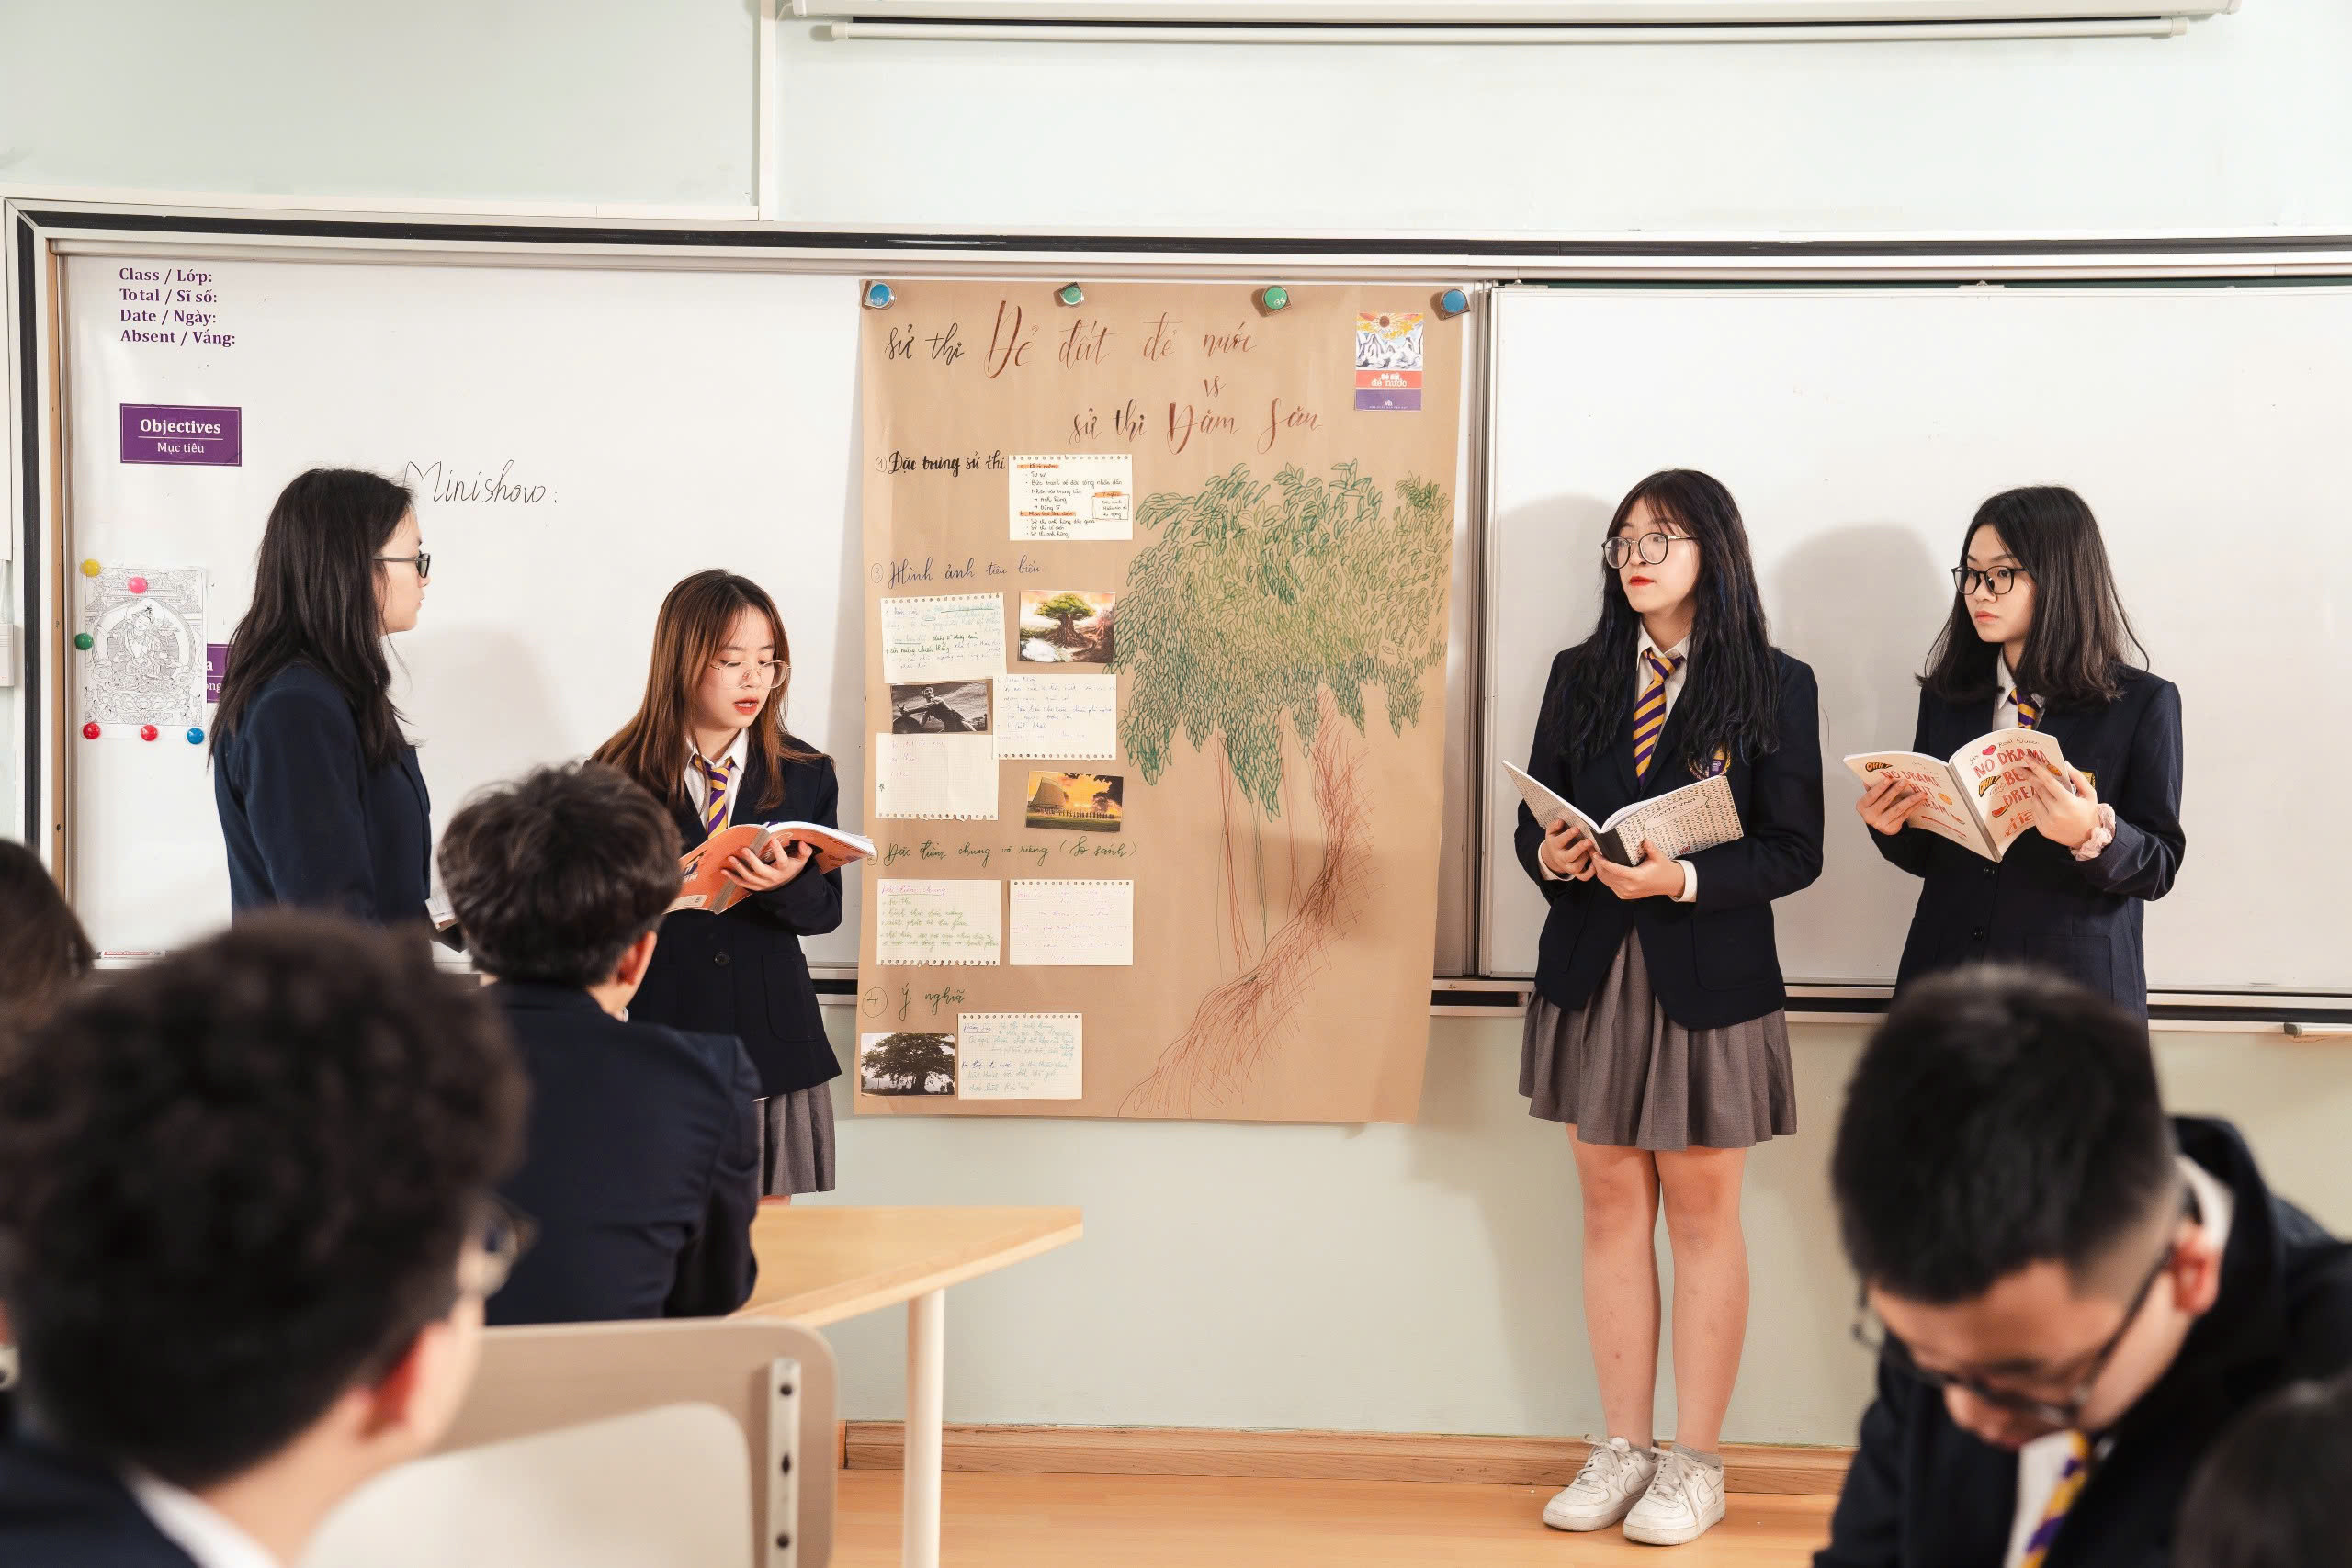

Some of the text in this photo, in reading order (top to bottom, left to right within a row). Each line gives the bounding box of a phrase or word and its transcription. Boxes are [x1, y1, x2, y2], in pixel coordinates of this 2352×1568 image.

[119, 267, 212, 286] Class / Lớp:
[119, 288, 217, 305] Total / Sĩ số:
[120, 309, 216, 326] Date / Ngày:
[120, 328, 235, 347] Absent / Vắng:
[925, 322, 965, 365] thi
[1204, 376, 1227, 398] vs
[140, 419, 221, 435] Objectives
[1113, 399, 1147, 442] thi
[157, 442, 205, 455] Mục tiêu
[986, 449, 1005, 469] thi
[945, 558, 975, 580] ảnh
[986, 562, 1008, 575] tiêu
[1973, 748, 2051, 779] NO DRAMA
[2003, 769, 2029, 786] BU
[958, 842, 992, 868] chung
